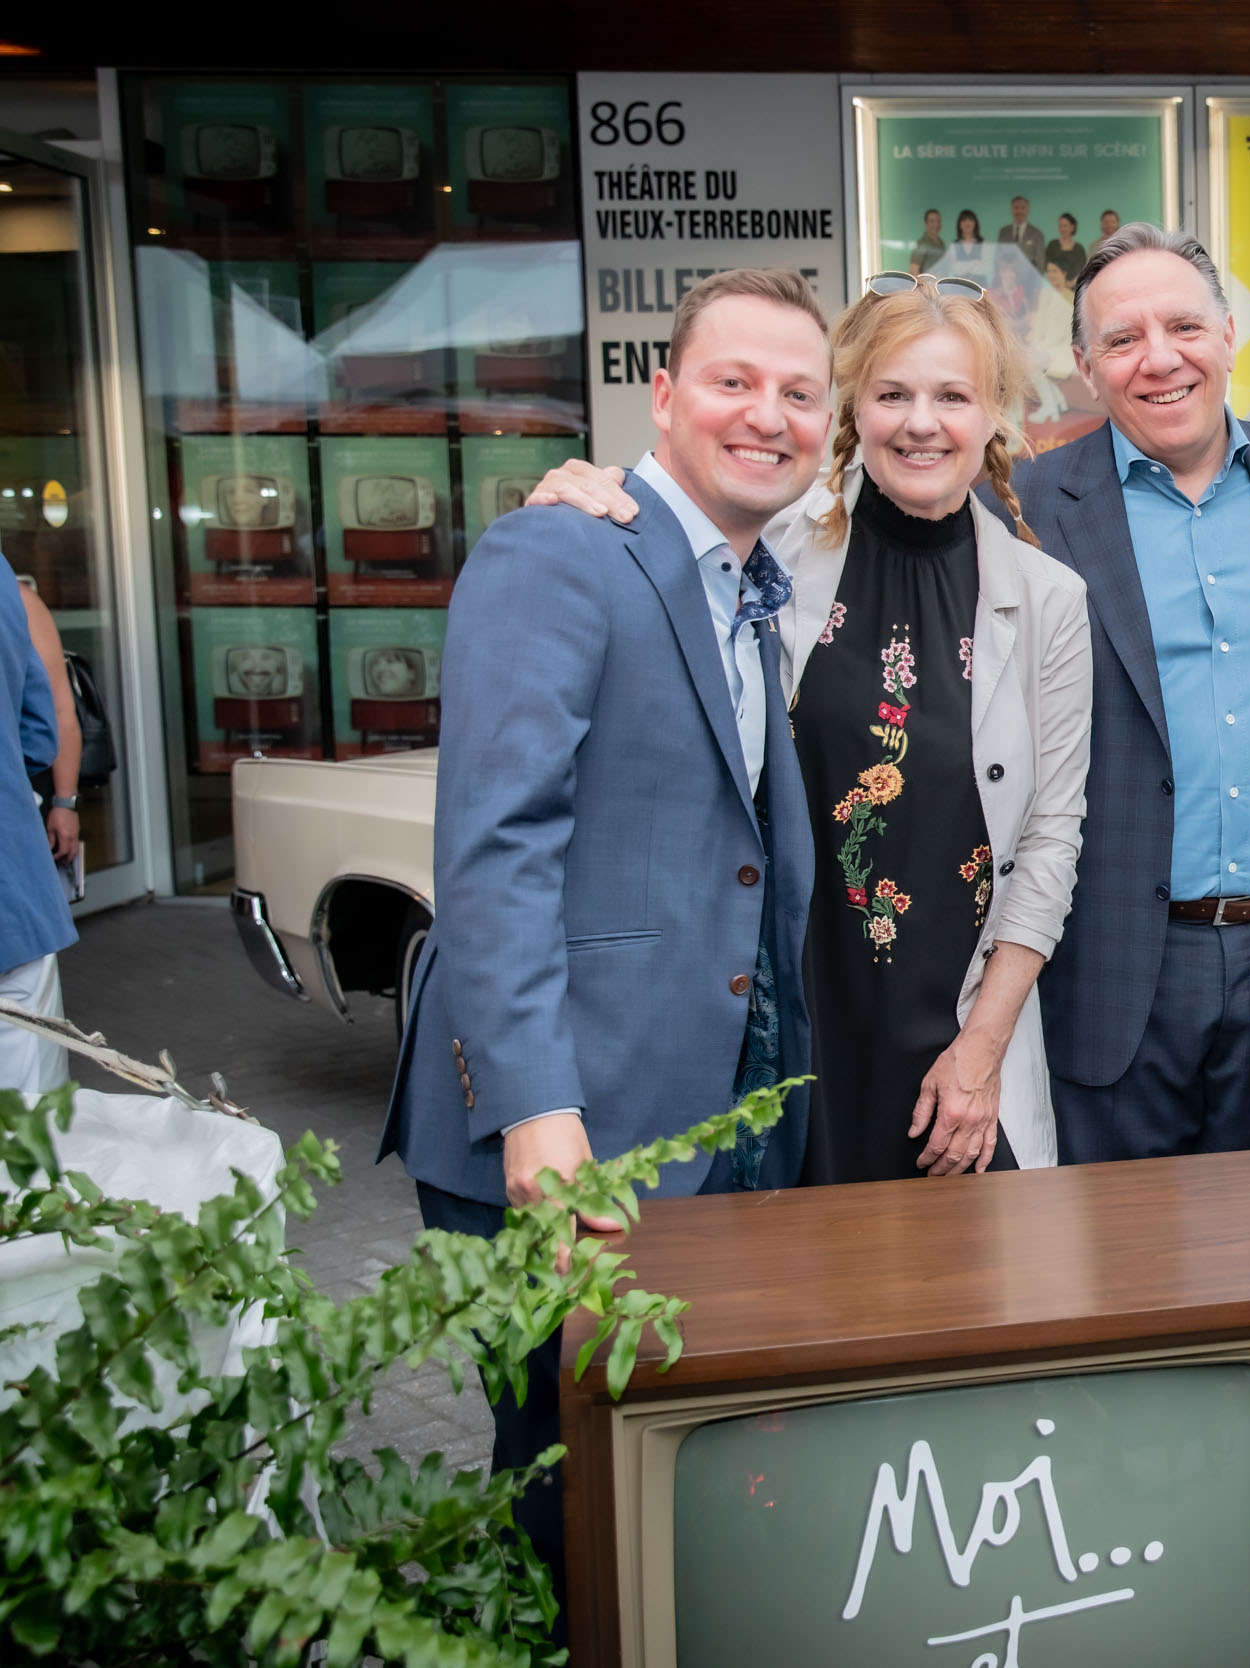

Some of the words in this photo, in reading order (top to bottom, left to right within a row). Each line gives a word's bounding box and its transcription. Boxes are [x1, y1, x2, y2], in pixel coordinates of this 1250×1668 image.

[590, 101, 685, 146] 866
[893, 145, 912, 159] LA
[917, 140, 957, 159] SÉRIE
[961, 144, 1008, 158] CULTE
[1012, 144, 1053, 158] ENFIN
[1060, 144, 1089, 158] SUR
[594, 164, 697, 200] THÉÂTRE
[705, 170, 737, 200] DU
[596, 209, 833, 240] VIEUX-TERREBONNE
